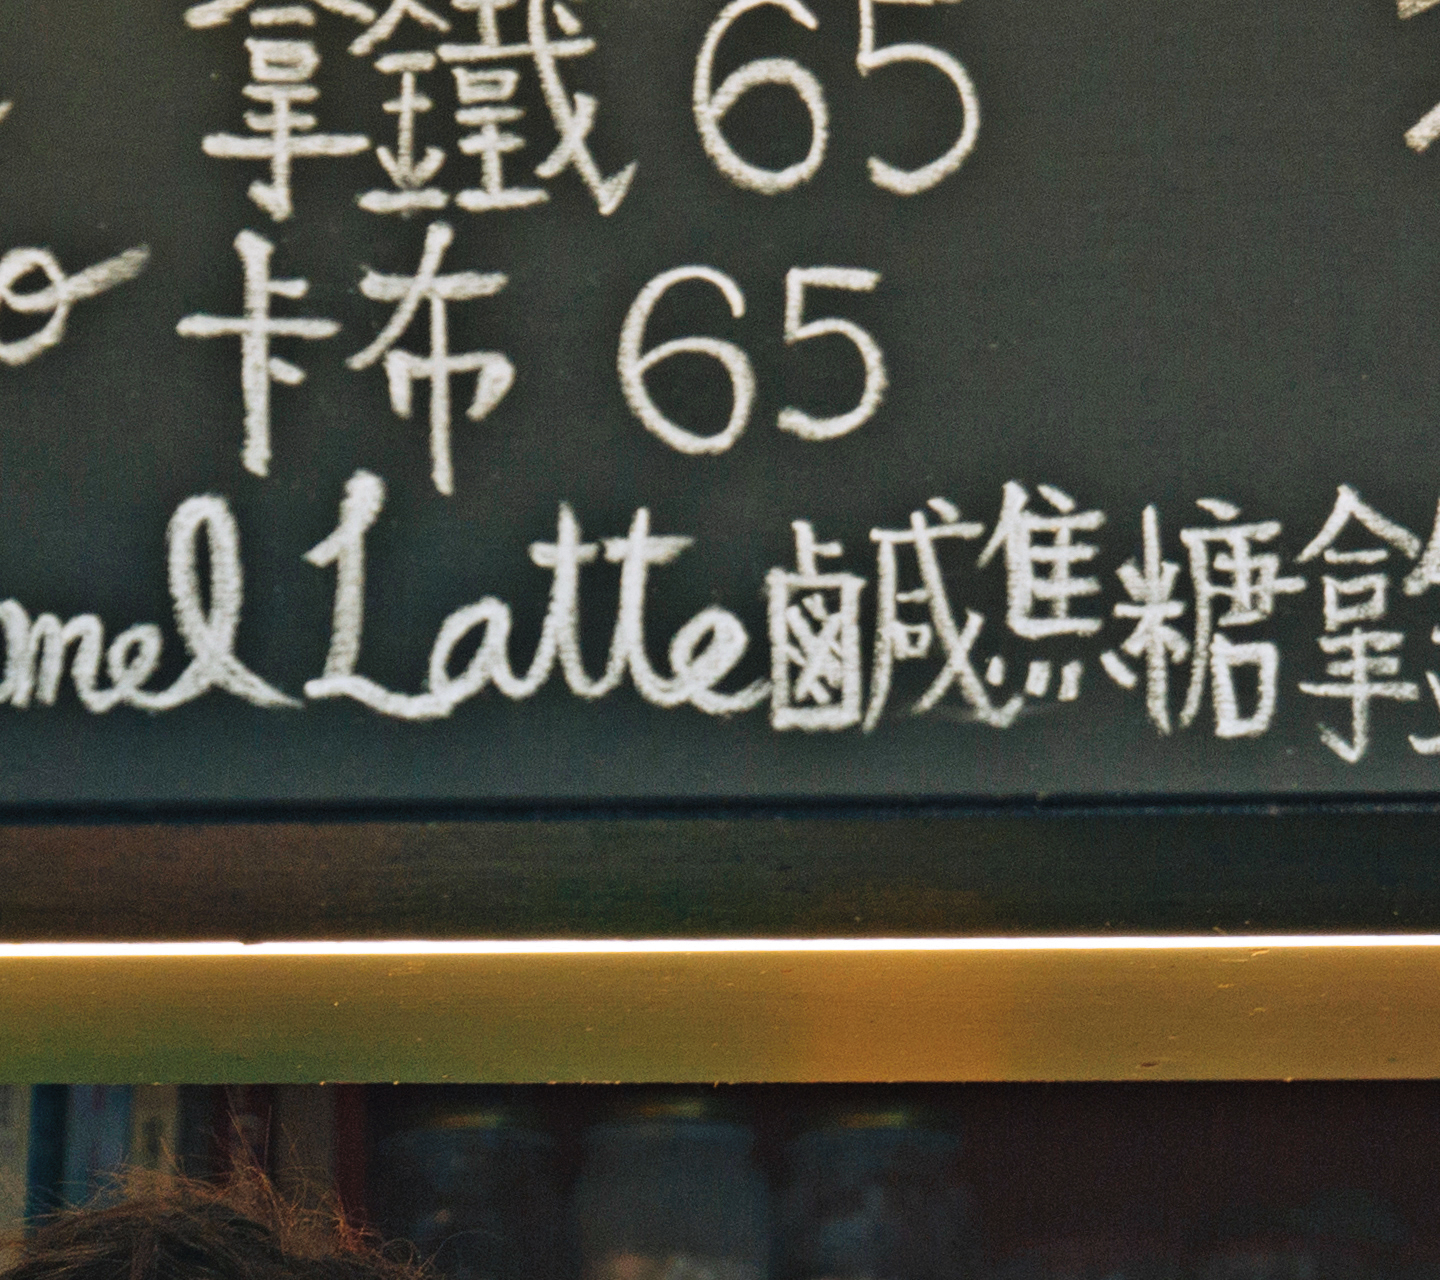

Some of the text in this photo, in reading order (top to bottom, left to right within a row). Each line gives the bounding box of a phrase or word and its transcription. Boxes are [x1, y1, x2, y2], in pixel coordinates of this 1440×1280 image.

[692, 0, 981, 194] 65
[176, 222, 516, 494] 卡布
[618, 265, 888, 454] 65
[303, 469, 768, 720] Latte
